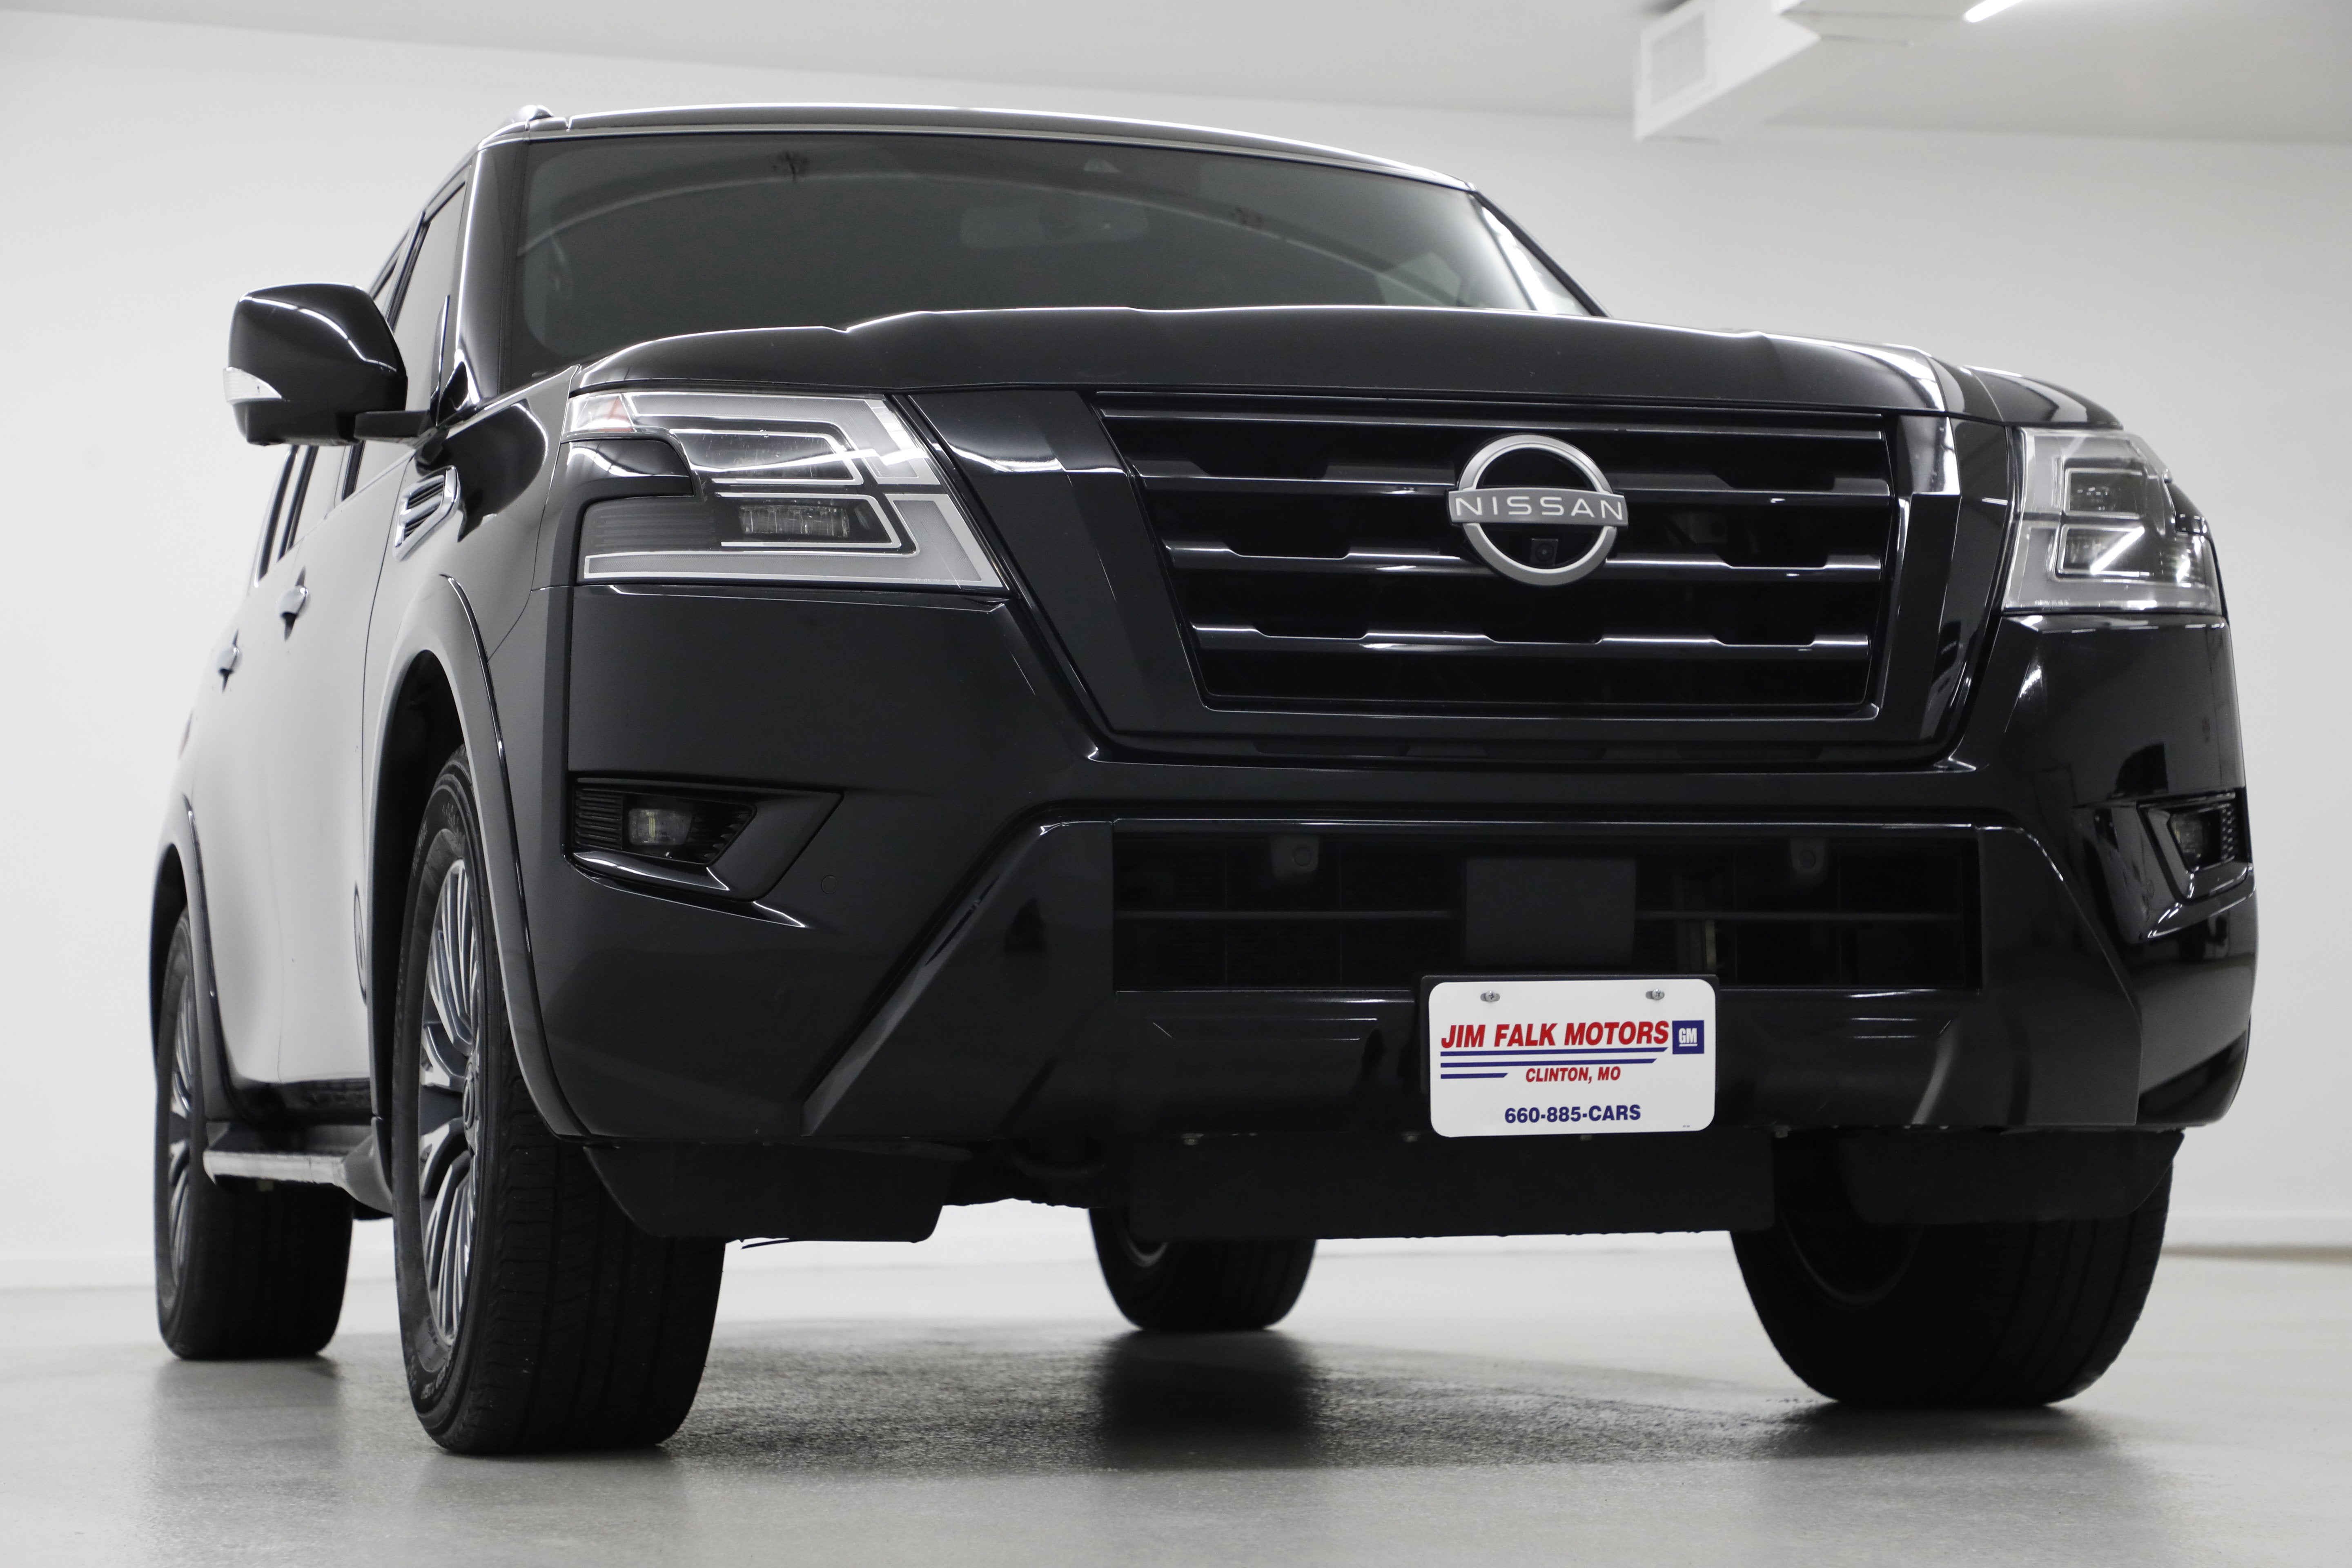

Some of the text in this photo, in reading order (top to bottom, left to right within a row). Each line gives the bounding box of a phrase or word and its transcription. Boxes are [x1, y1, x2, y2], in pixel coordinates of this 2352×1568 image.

[1455, 495, 1623, 521] NISSAN
[1441, 1020, 1669, 1049] JIM FALK MOTORS
[1678, 1027, 1697, 1044] GM
[1526, 1066, 1621, 1084] CLINTON, MO
[1505, 1105, 1641, 1123] 660-885-CARS
